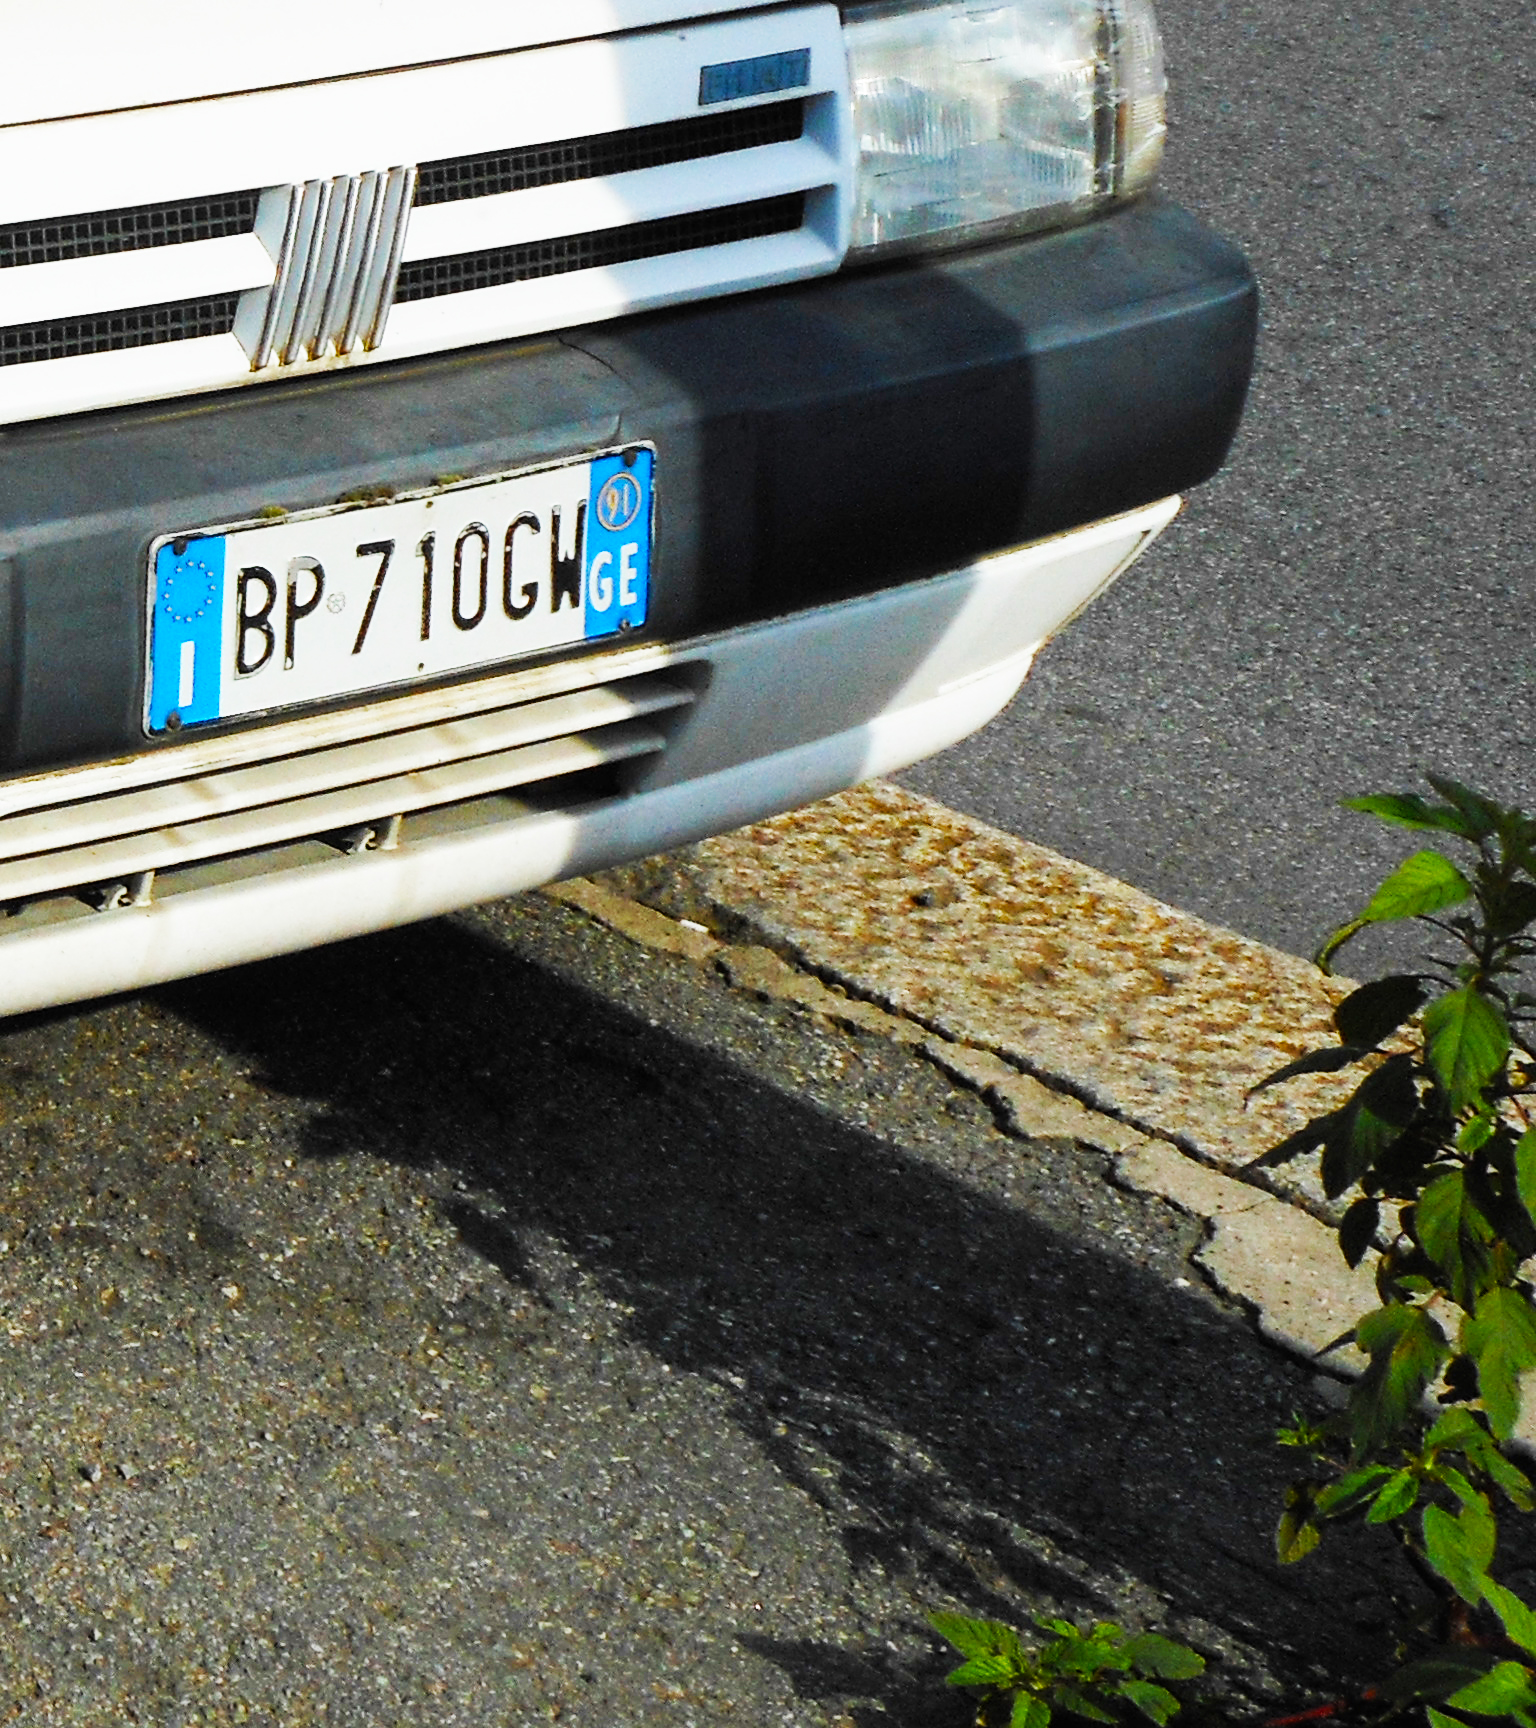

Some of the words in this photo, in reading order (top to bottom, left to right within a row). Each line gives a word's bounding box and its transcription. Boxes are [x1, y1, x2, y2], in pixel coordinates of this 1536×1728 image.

[606, 483, 628, 522] 91
[234, 555, 326, 680] BP
[350, 499, 588, 655] 710GW
[588, 543, 639, 613] GE
